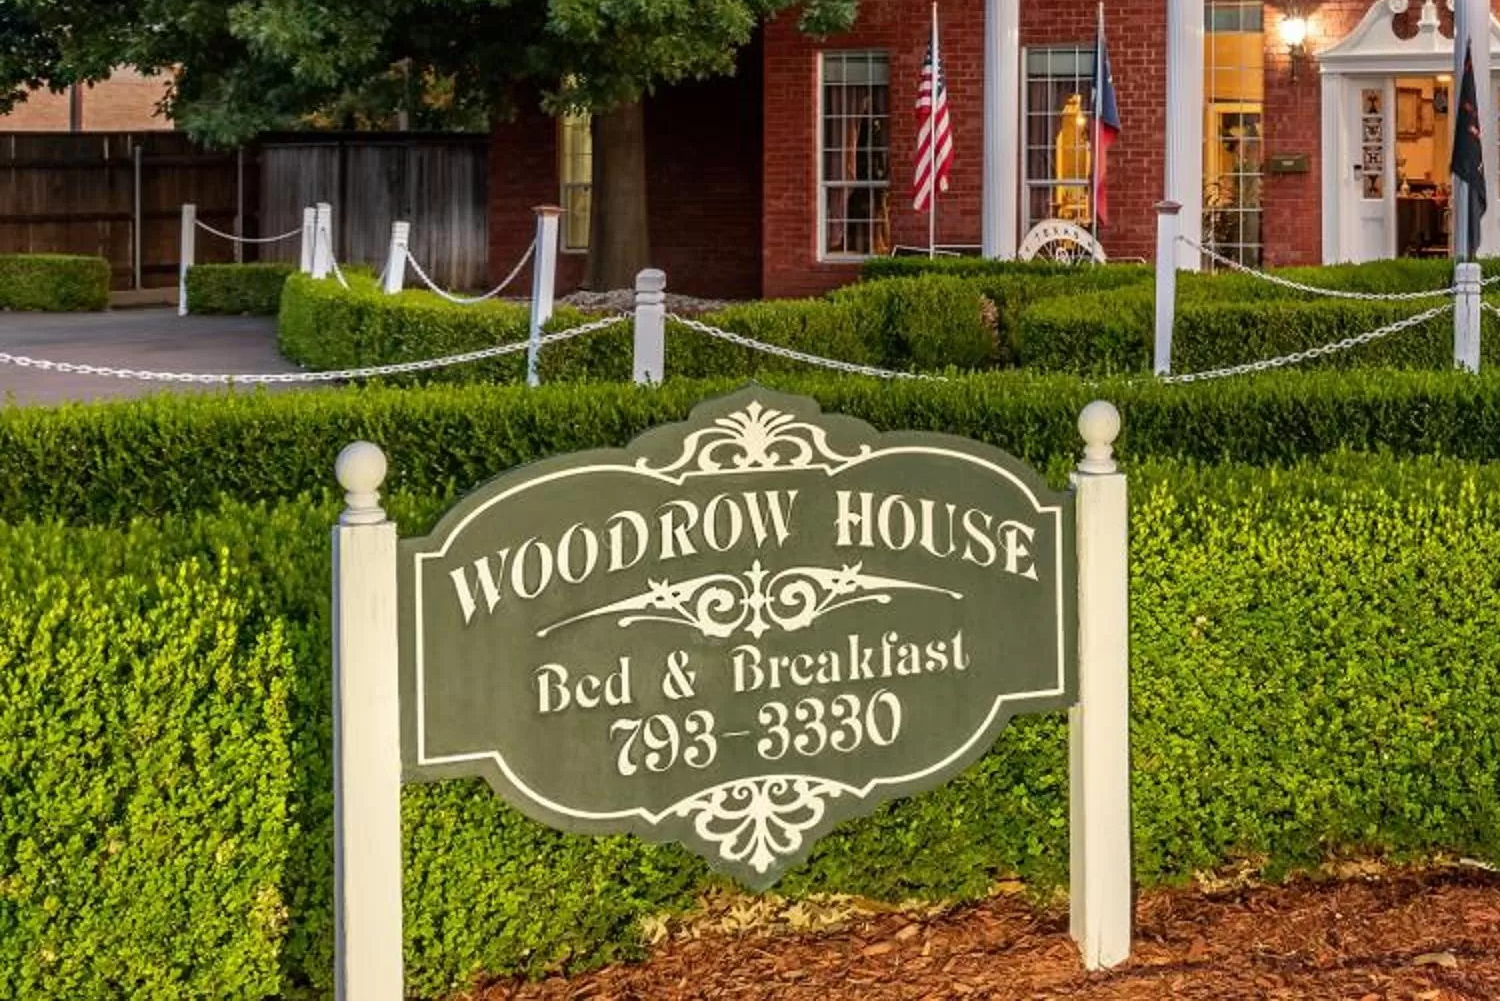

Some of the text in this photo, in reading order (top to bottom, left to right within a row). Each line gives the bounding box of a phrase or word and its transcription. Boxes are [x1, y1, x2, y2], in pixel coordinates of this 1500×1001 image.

[448, 489, 1040, 625] WOODROW HOUSE
[536, 629, 970, 713] Bed & Breakfast
[608, 688, 903, 777] 793-3330
